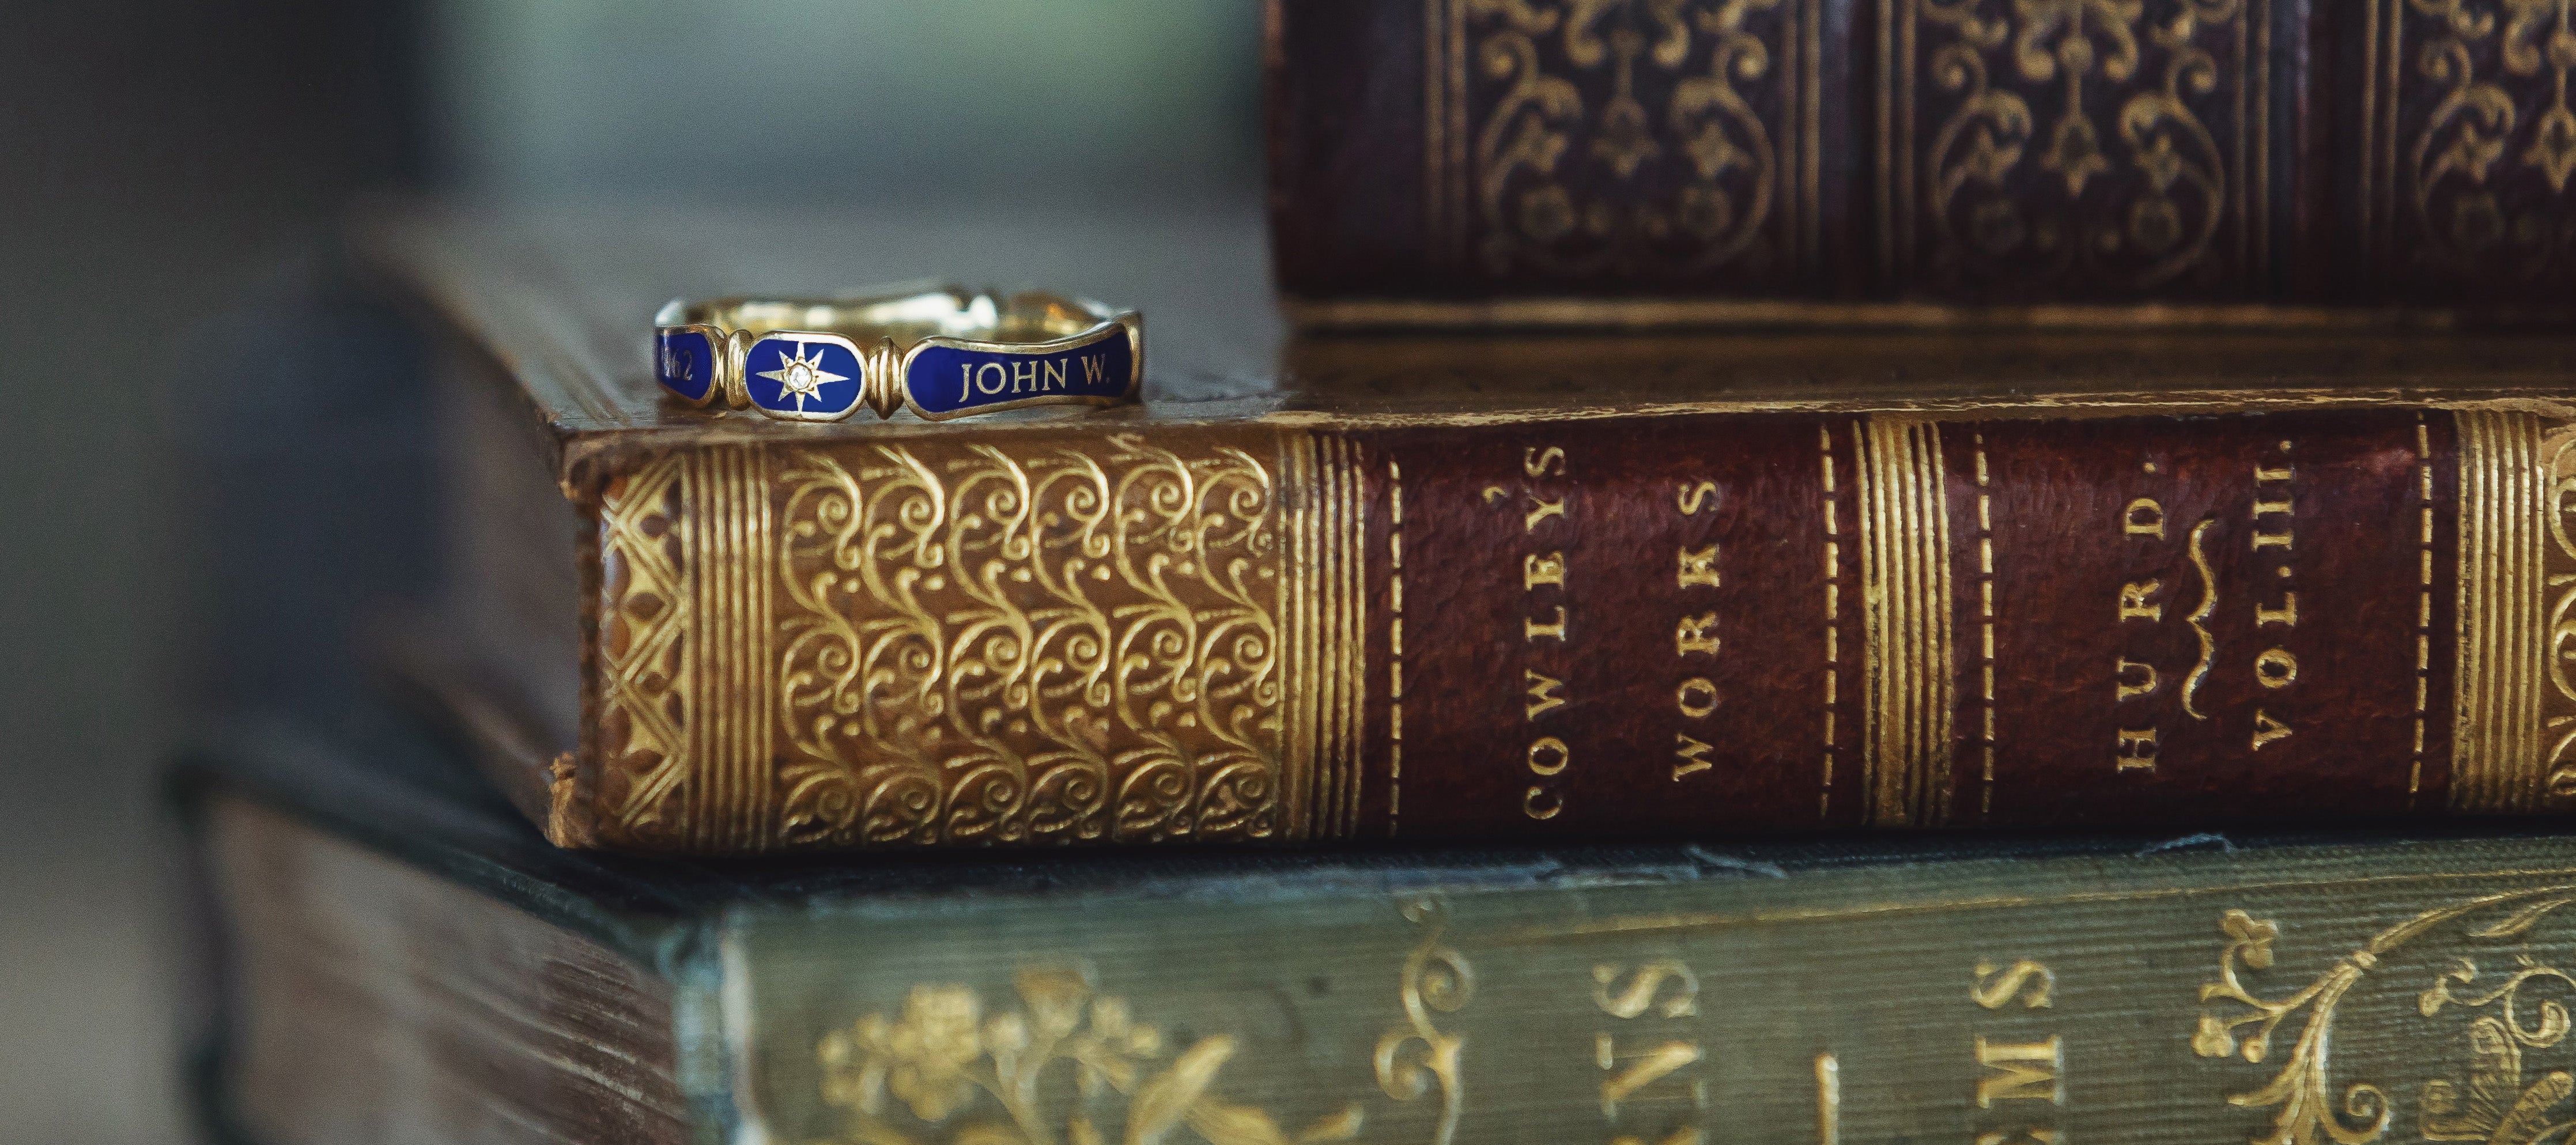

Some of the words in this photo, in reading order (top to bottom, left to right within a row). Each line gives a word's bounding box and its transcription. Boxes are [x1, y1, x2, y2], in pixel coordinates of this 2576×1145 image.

[958, 357, 1068, 403] JOHN
[1081, 353, 1110, 386] W.
[1482, 446, 1569, 820] COWLEY'S
[1673, 482, 1721, 782] WORKS
[2117, 462, 2166, 773] HURD.
[1592, 958, 1706, 1145] NS
